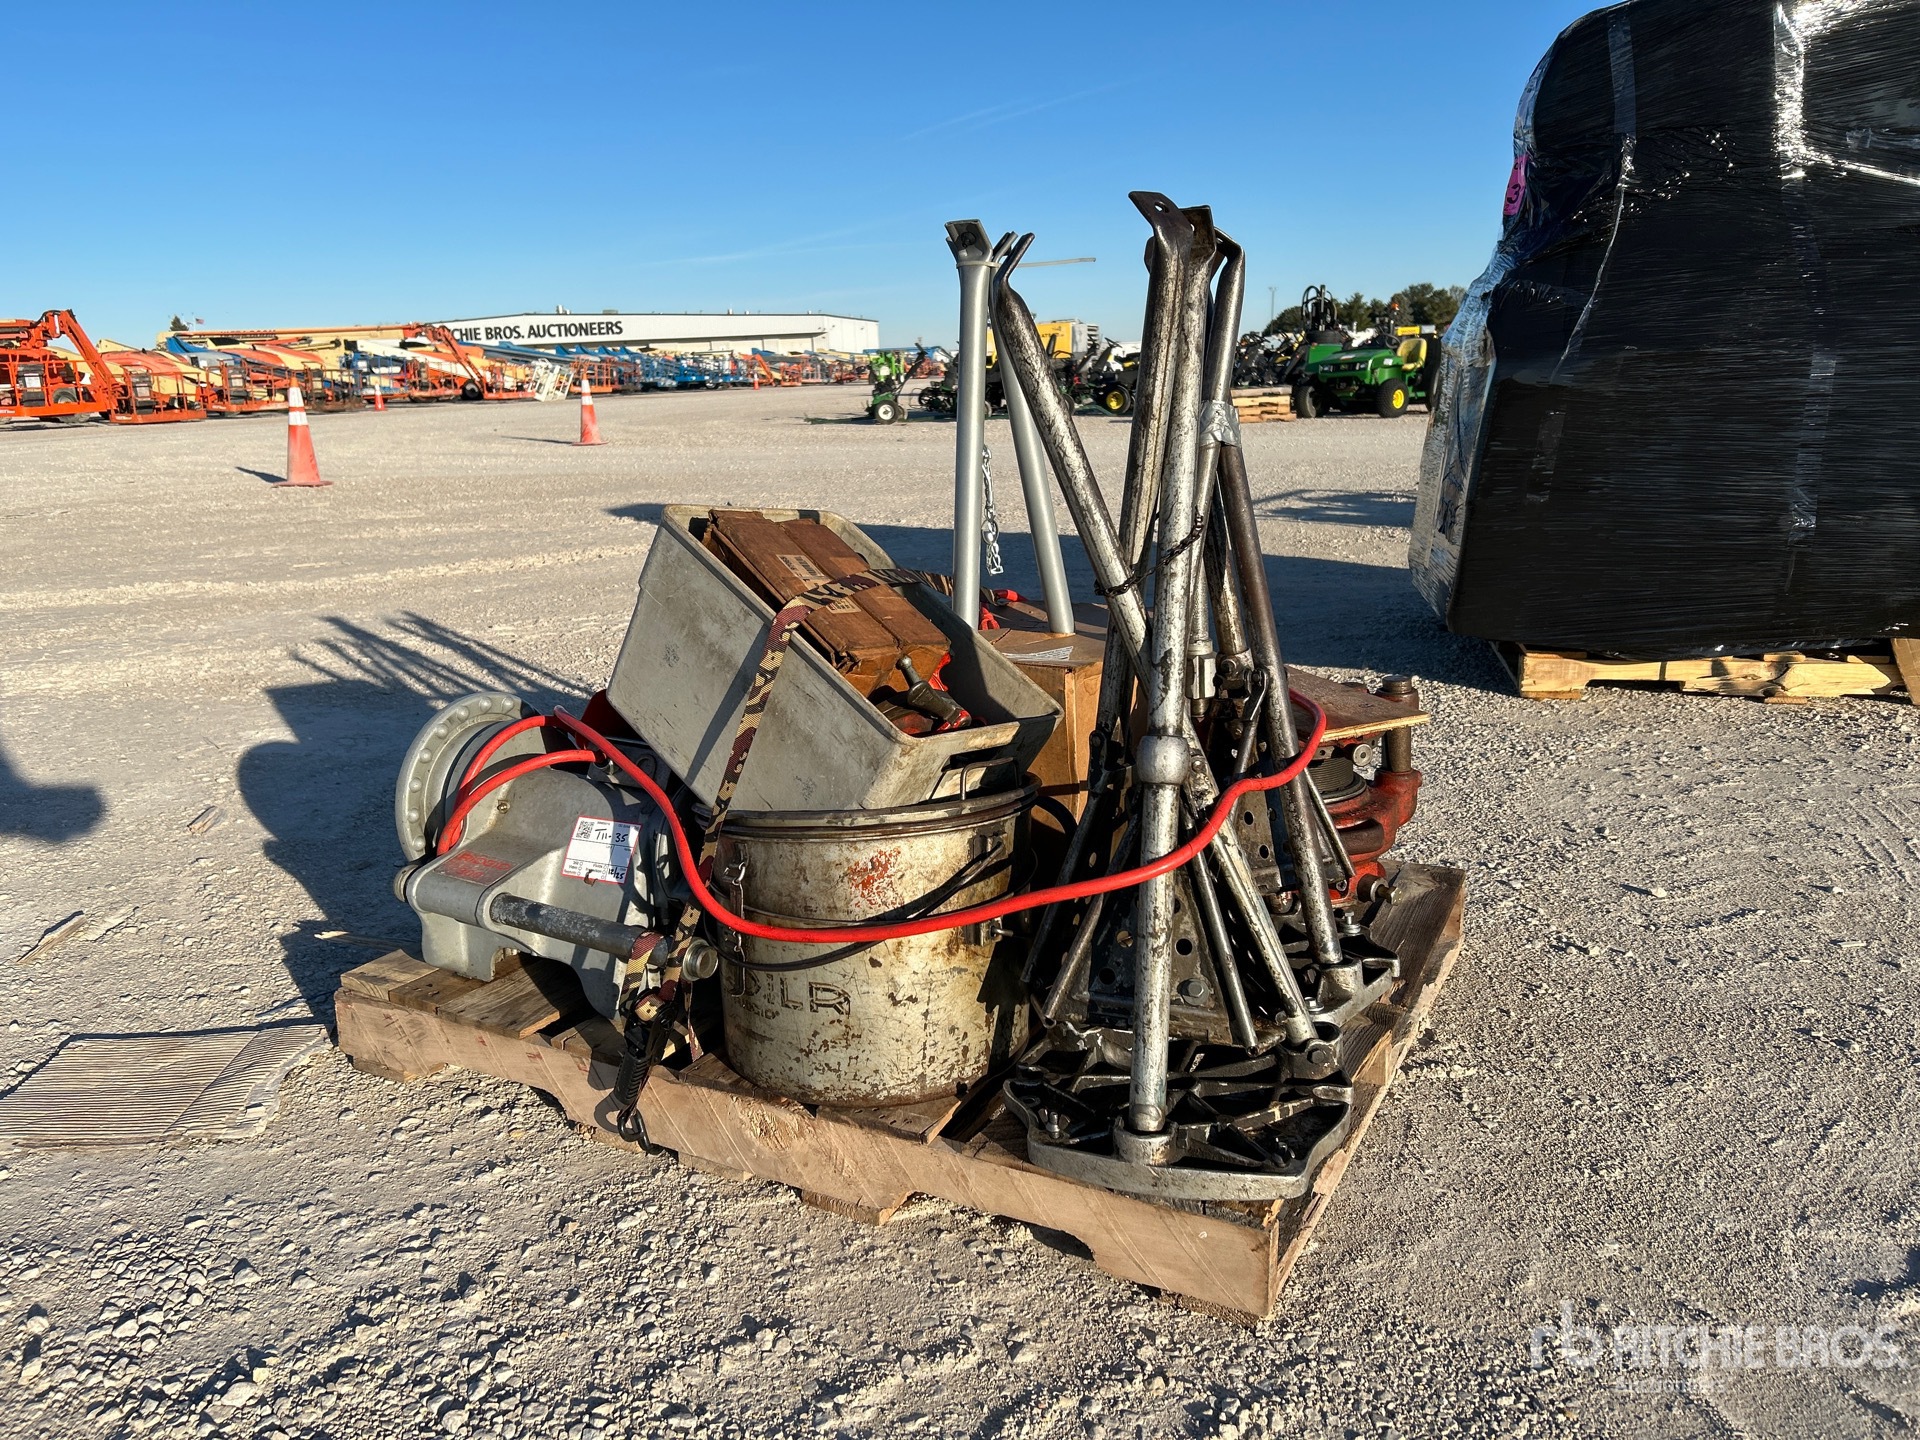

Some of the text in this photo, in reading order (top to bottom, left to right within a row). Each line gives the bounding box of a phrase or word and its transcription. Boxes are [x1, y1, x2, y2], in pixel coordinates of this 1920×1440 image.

[451, 320, 623, 341] CHIE BROS. AUCTIONEERS
